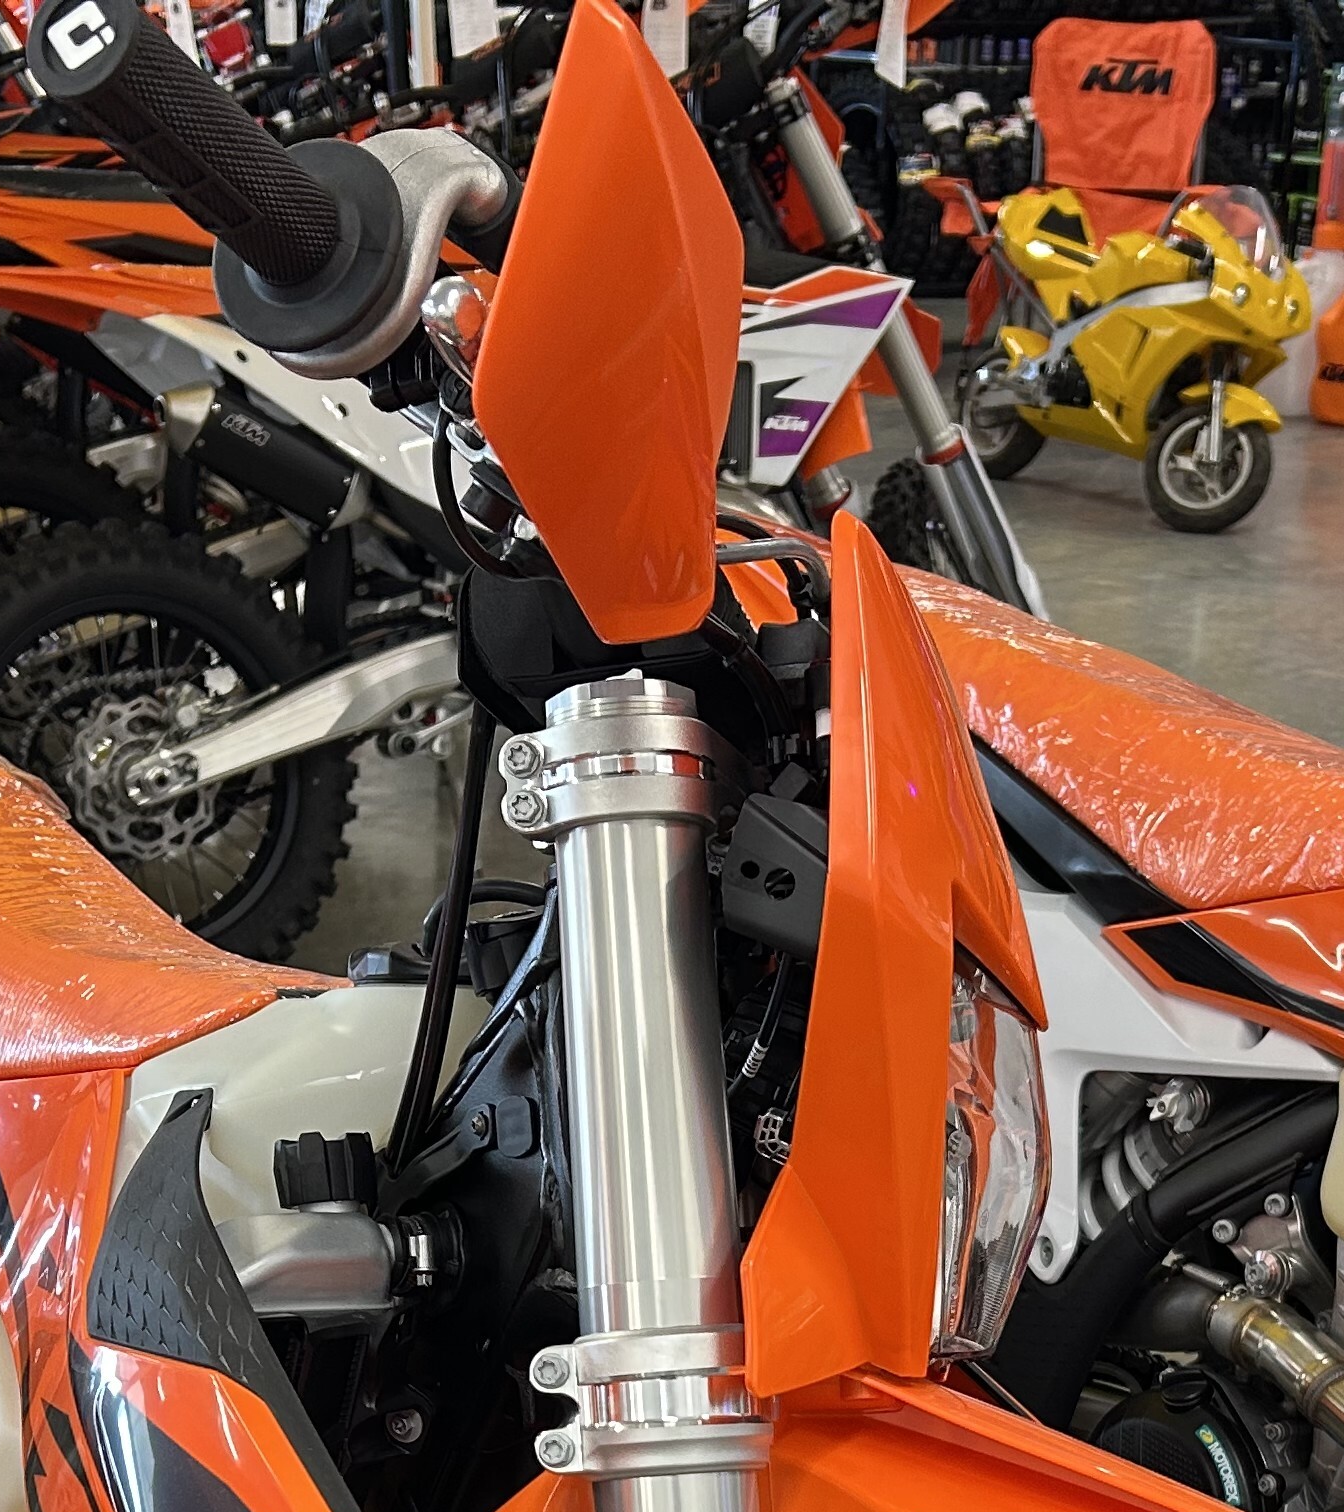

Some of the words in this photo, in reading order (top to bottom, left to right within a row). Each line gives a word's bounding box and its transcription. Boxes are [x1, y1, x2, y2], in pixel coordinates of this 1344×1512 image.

[1079, 57, 1173, 95] KTM
[221, 413, 271, 447] KTM
[762, 415, 810, 432] KTM
[1207, 1441, 1240, 1503] MOTOREX
